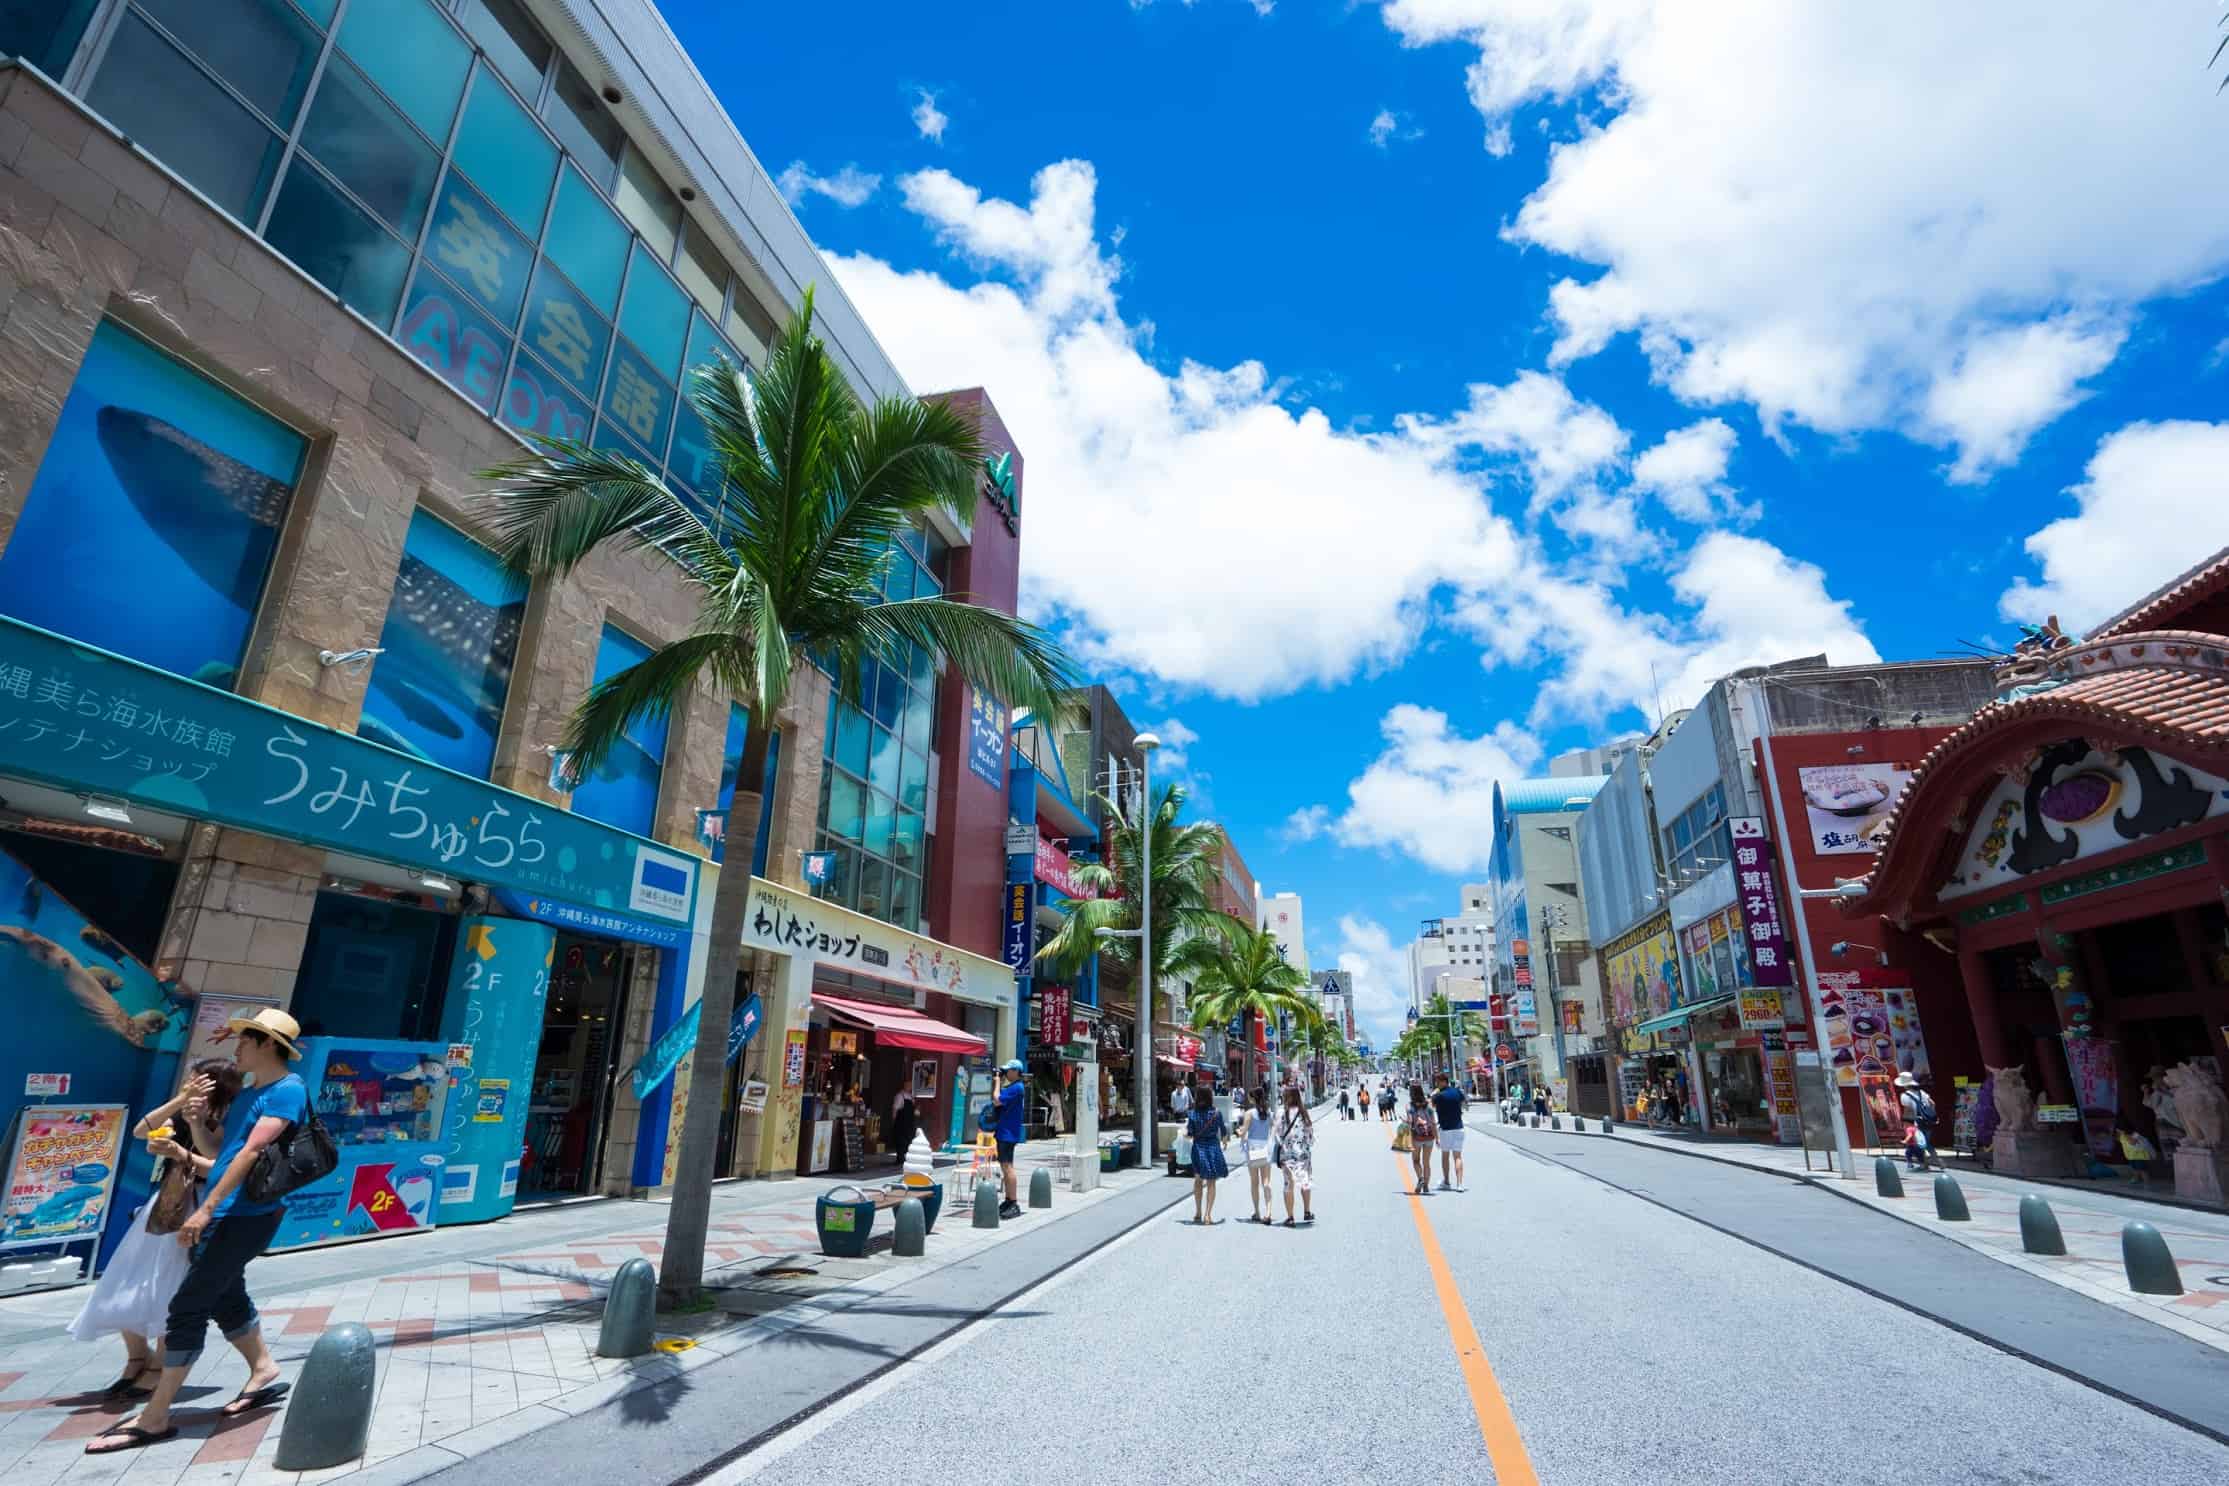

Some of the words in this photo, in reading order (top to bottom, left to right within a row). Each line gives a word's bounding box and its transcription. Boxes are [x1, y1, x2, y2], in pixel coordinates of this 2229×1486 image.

[438, 195, 660, 443] 英会話
[402, 297, 590, 463] AEON
[263, 724, 546, 868] うみちゅらら
[540, 902, 553, 915] 2F
[754, 904, 861, 958] わしたショップ
[1736, 847, 1778, 967] 御菓子御殿
[462, 961, 503, 992] 2F
[370, 1189, 396, 1213] 2F
